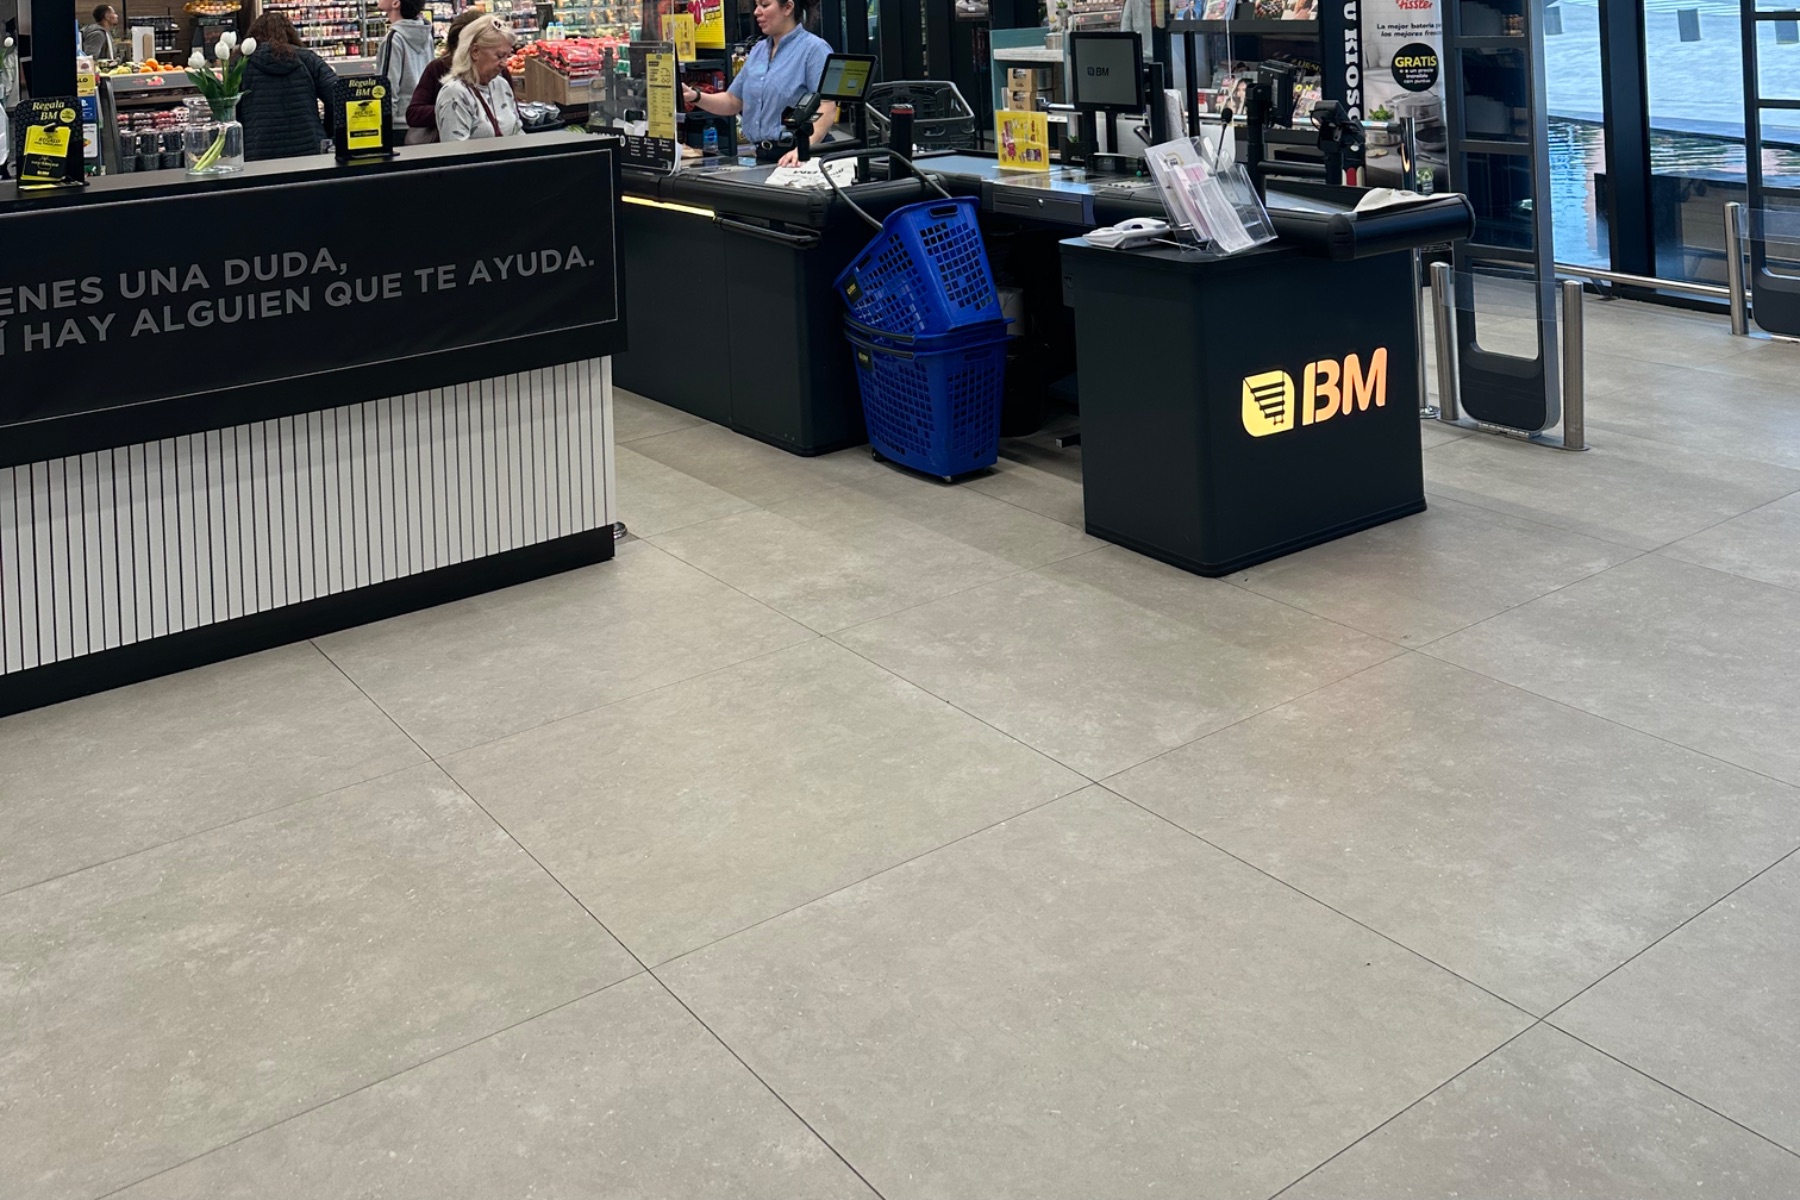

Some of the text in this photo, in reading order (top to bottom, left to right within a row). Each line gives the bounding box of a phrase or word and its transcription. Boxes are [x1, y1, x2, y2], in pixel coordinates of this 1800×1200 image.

[1388, 23, 1408, 31] mejor
[1394, 55, 1437, 68] GRATIS
[1096, 67, 1109, 76] BM
[348, 78, 376, 88] Regala
[355, 88, 370, 97] BM
[1344, 28, 1360, 151] KIOSC
[32, 100, 65, 111] Regala
[40, 111, 58, 121] BM
[119, 264, 210, 300] UNA
[224, 247, 347, 286] DUDA,
[24, 313, 116, 351] HAY
[130, 286, 311, 337] ALGUIEN
[324, 272, 402, 307] QUE
[414, 264, 456, 293] TE
[468, 245, 594, 285] AYUDA.
[1302, 347, 1388, 426] BM
